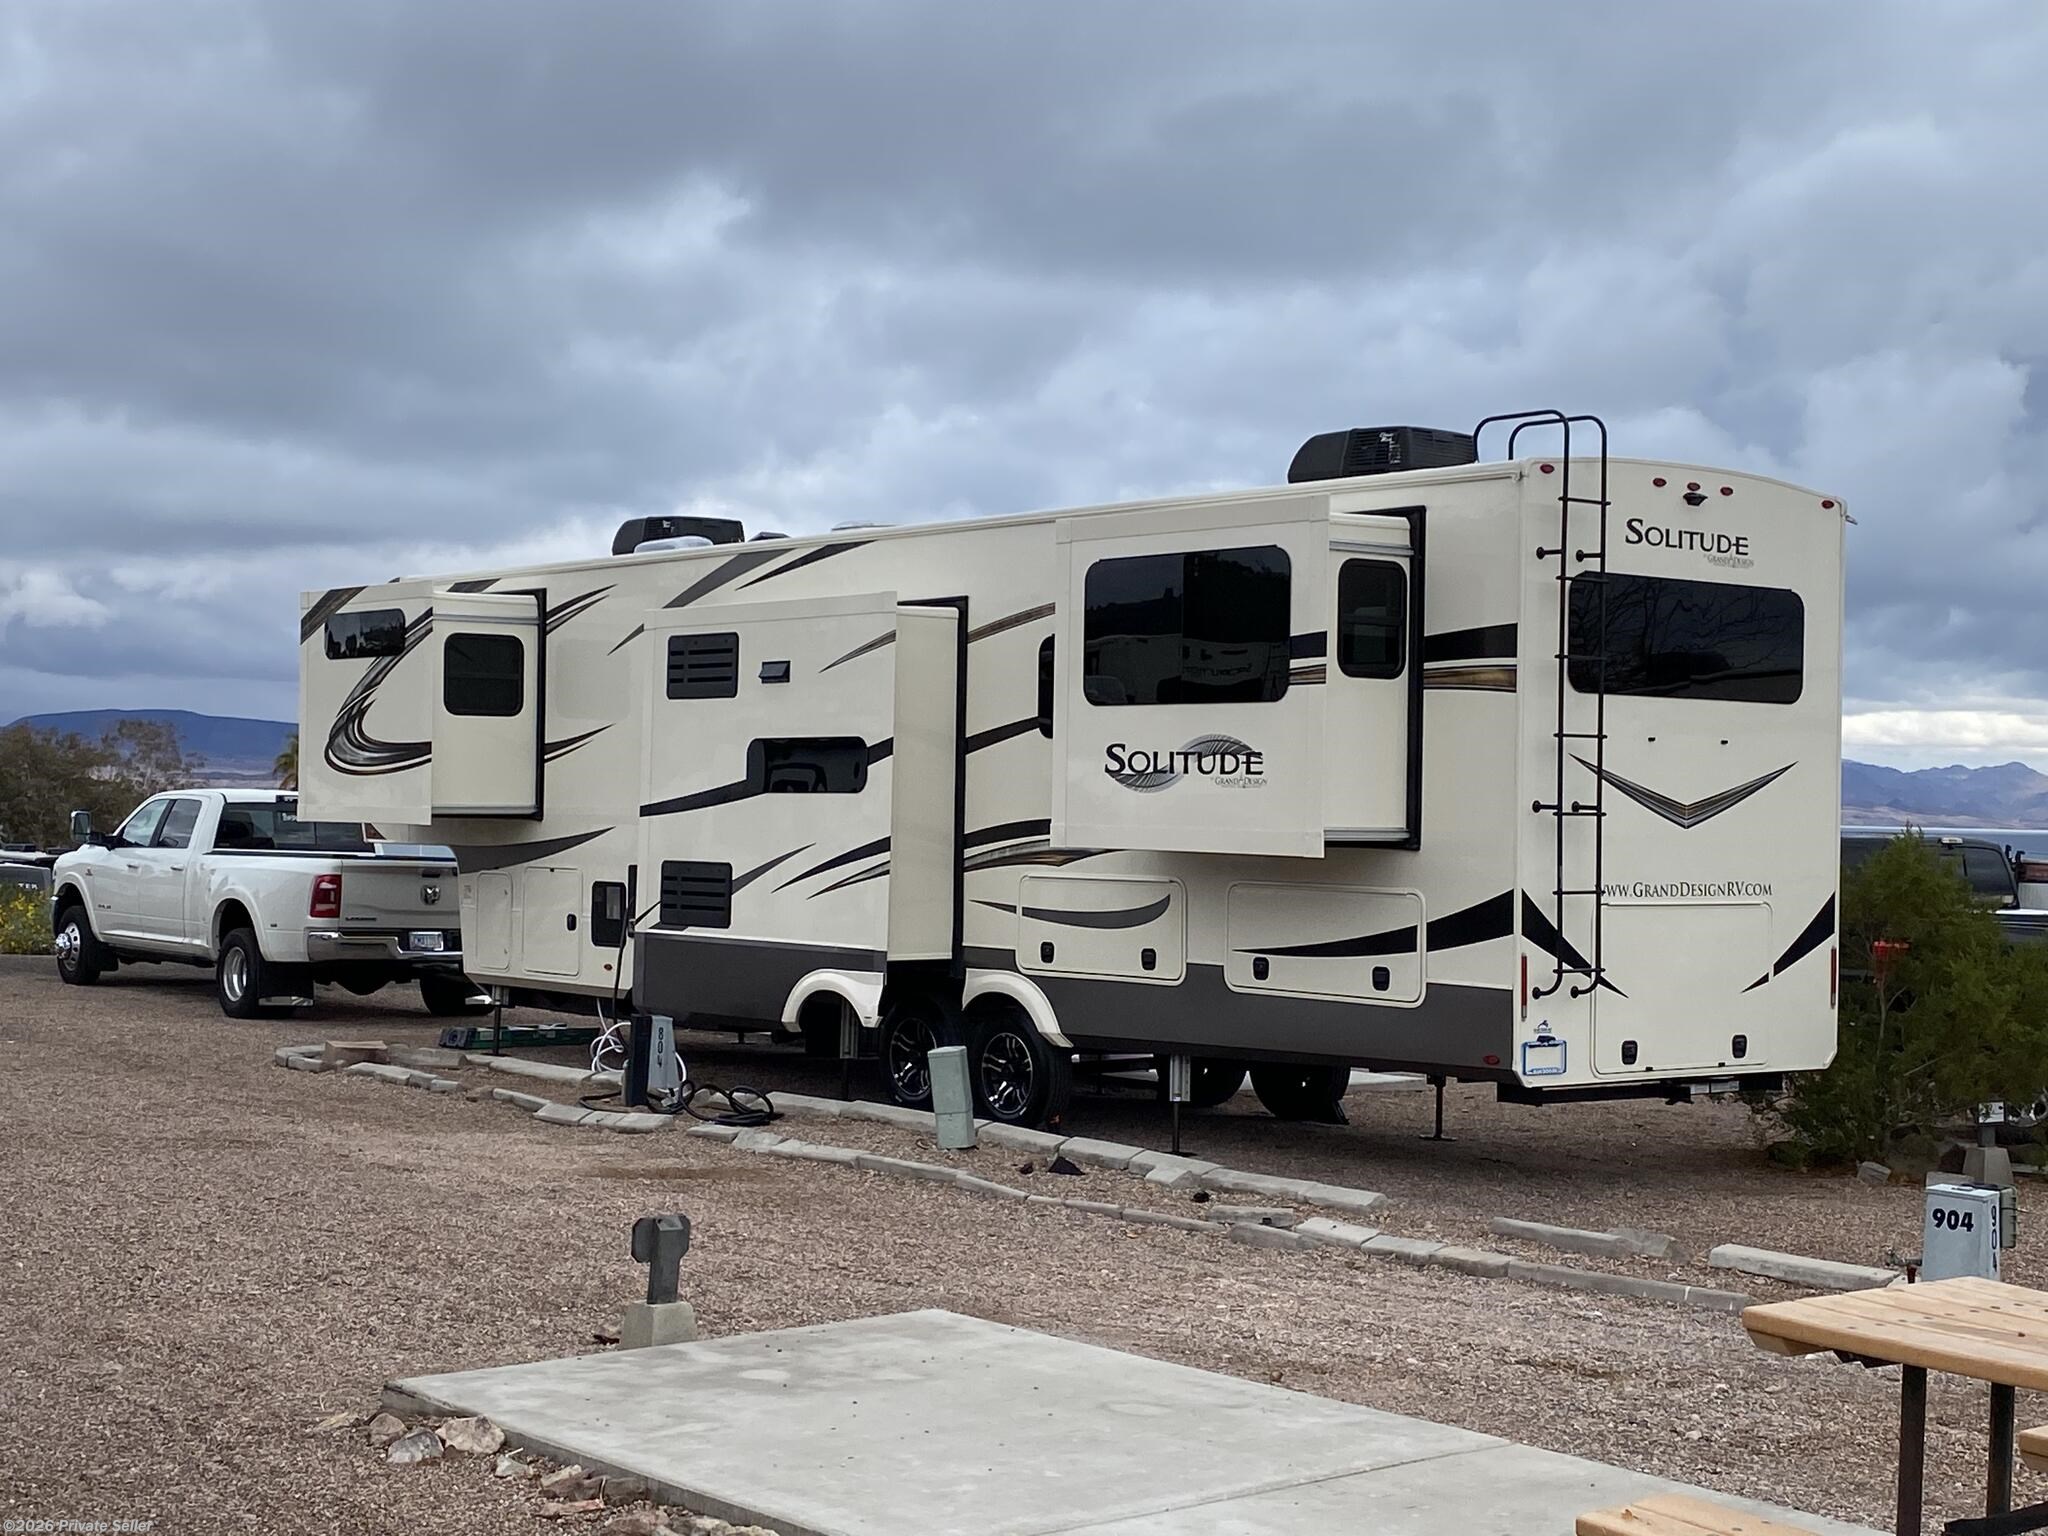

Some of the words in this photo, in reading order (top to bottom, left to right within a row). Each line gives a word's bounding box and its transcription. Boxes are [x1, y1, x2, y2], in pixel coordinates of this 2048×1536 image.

[1625, 518, 1749, 556] SOLITUDE
[1104, 743, 1264, 776] SOLITUDE
[1932, 1207, 1974, 1232] 904
[1990, 1204, 1998, 1273] 904
